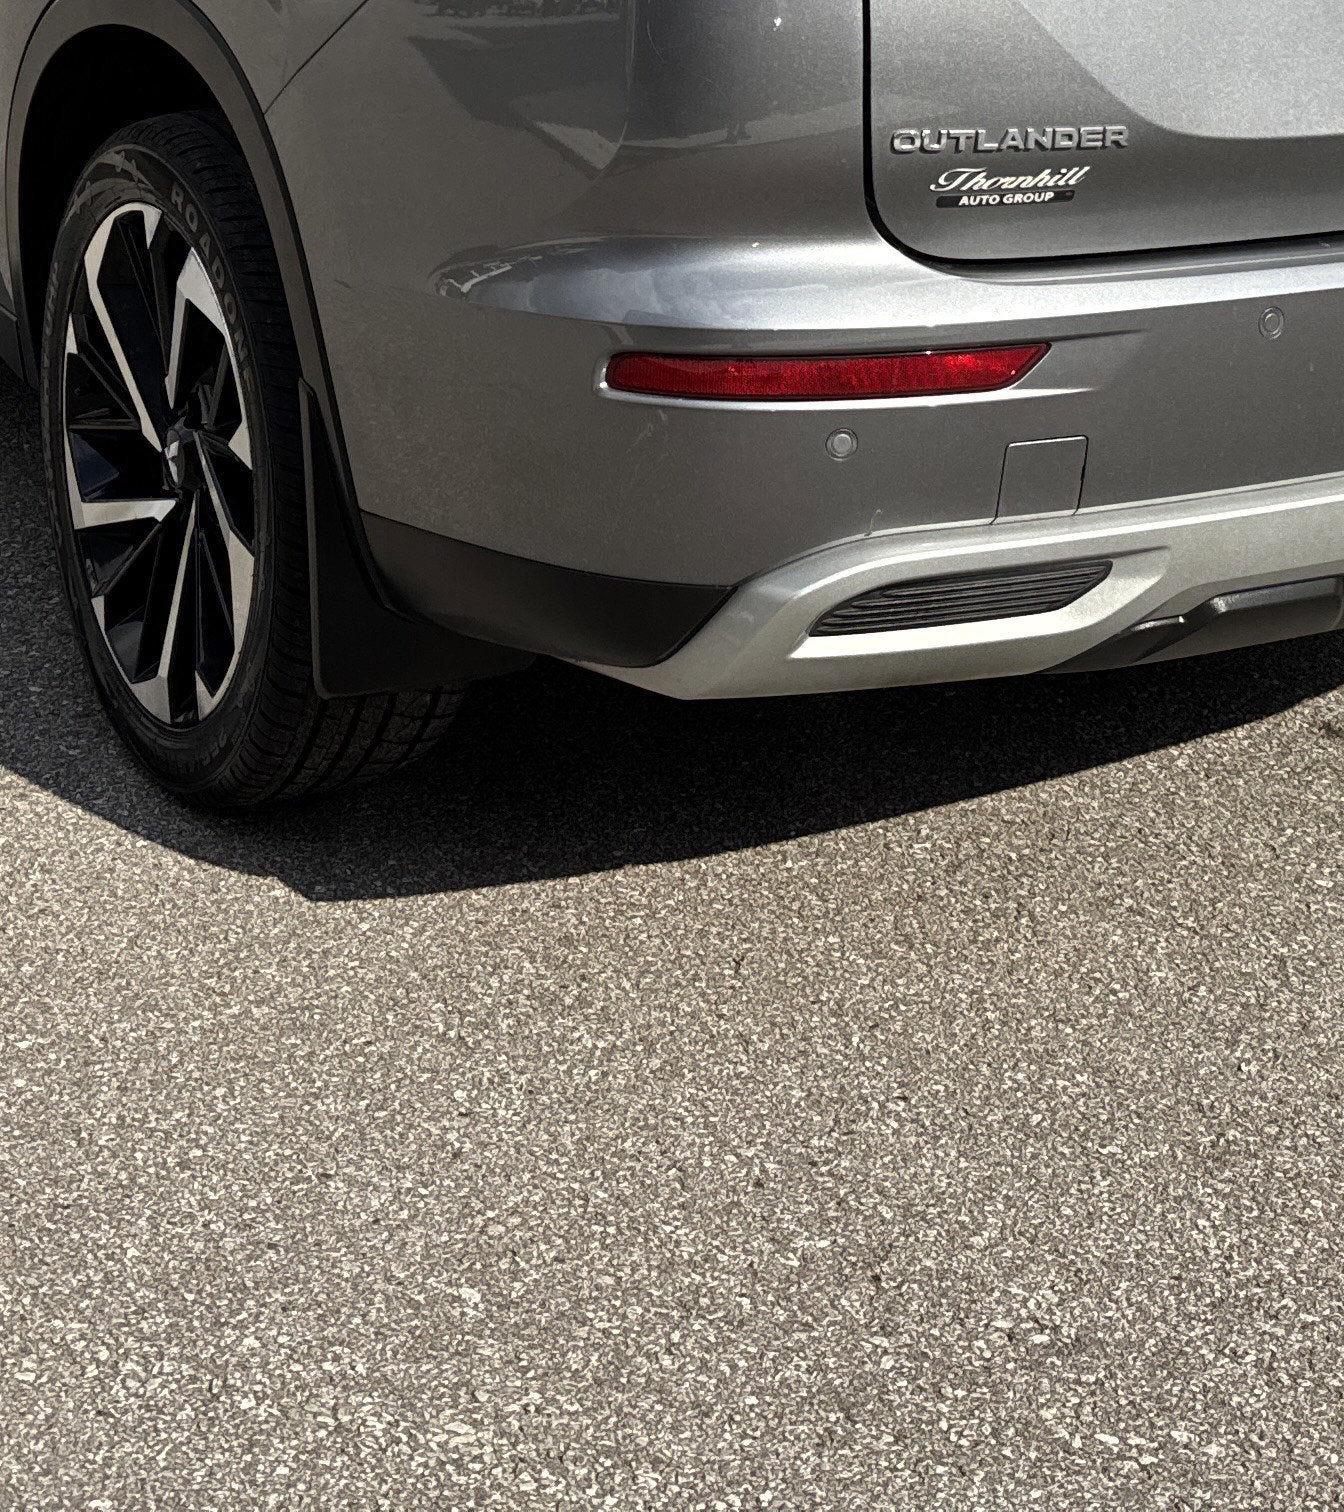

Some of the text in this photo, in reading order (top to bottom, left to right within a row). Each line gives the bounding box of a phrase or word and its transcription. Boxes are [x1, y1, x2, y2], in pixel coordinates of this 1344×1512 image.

[891, 125, 1130, 154] OUTLANDER
[929, 165, 1091, 192] Thornhill
[958, 191, 1055, 207] AUTO GROUP
